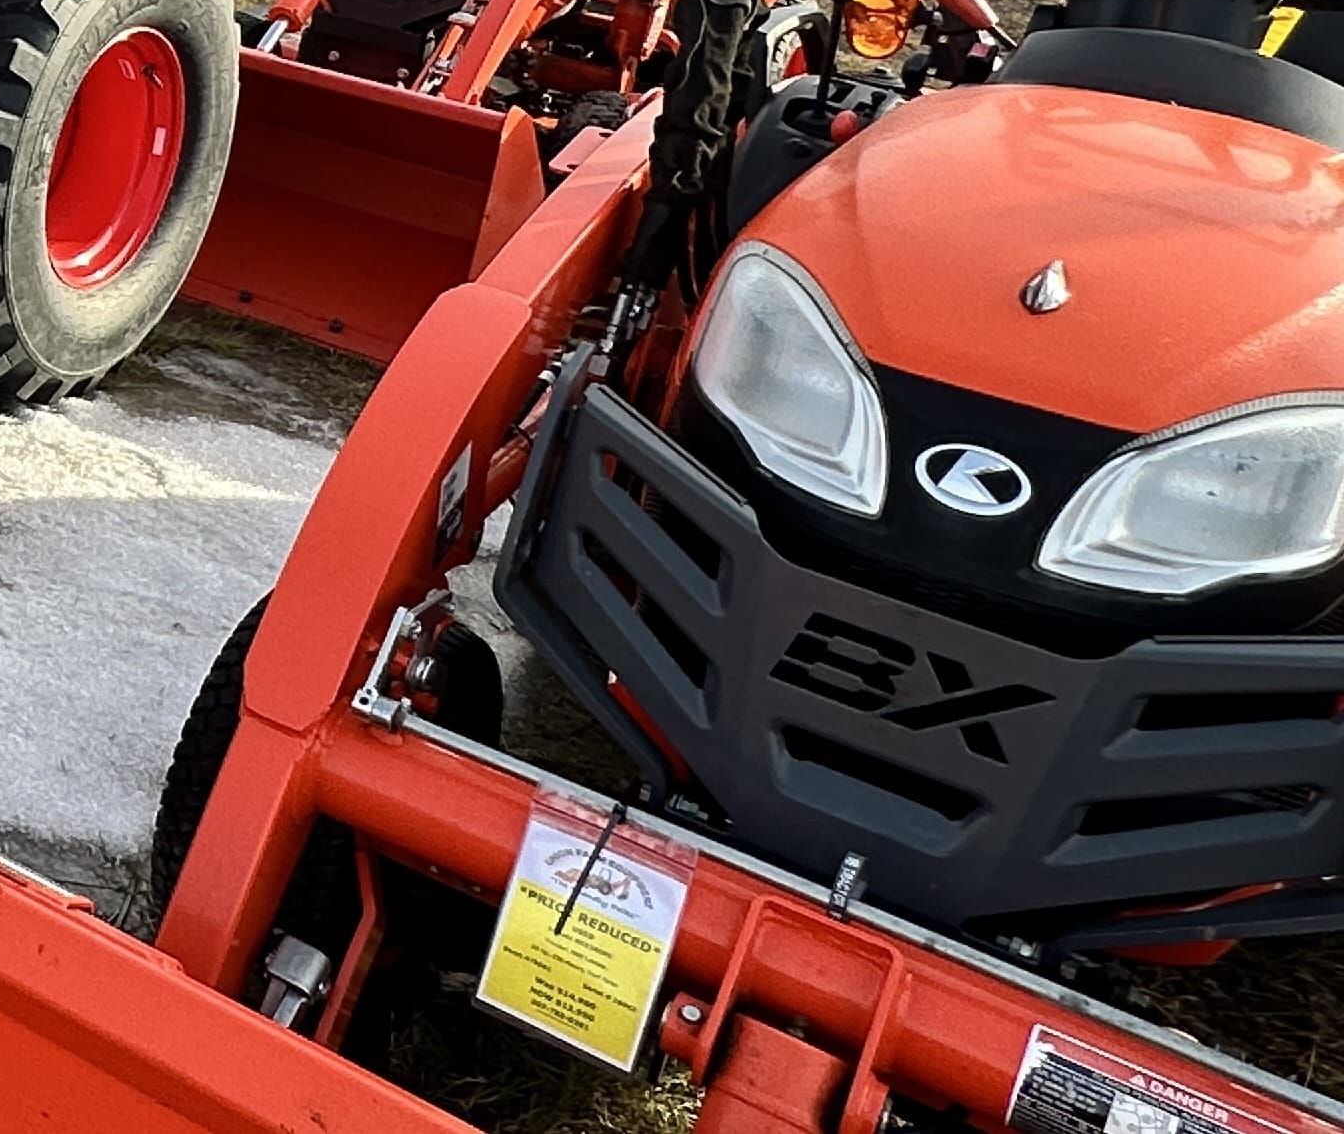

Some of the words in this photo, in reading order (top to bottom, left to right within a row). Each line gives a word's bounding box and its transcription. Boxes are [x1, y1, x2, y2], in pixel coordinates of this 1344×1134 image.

[769, 612, 1057, 764] BX
[518, 884, 572, 917] PRIC
[1148, 1080, 1230, 1124] DANGER
